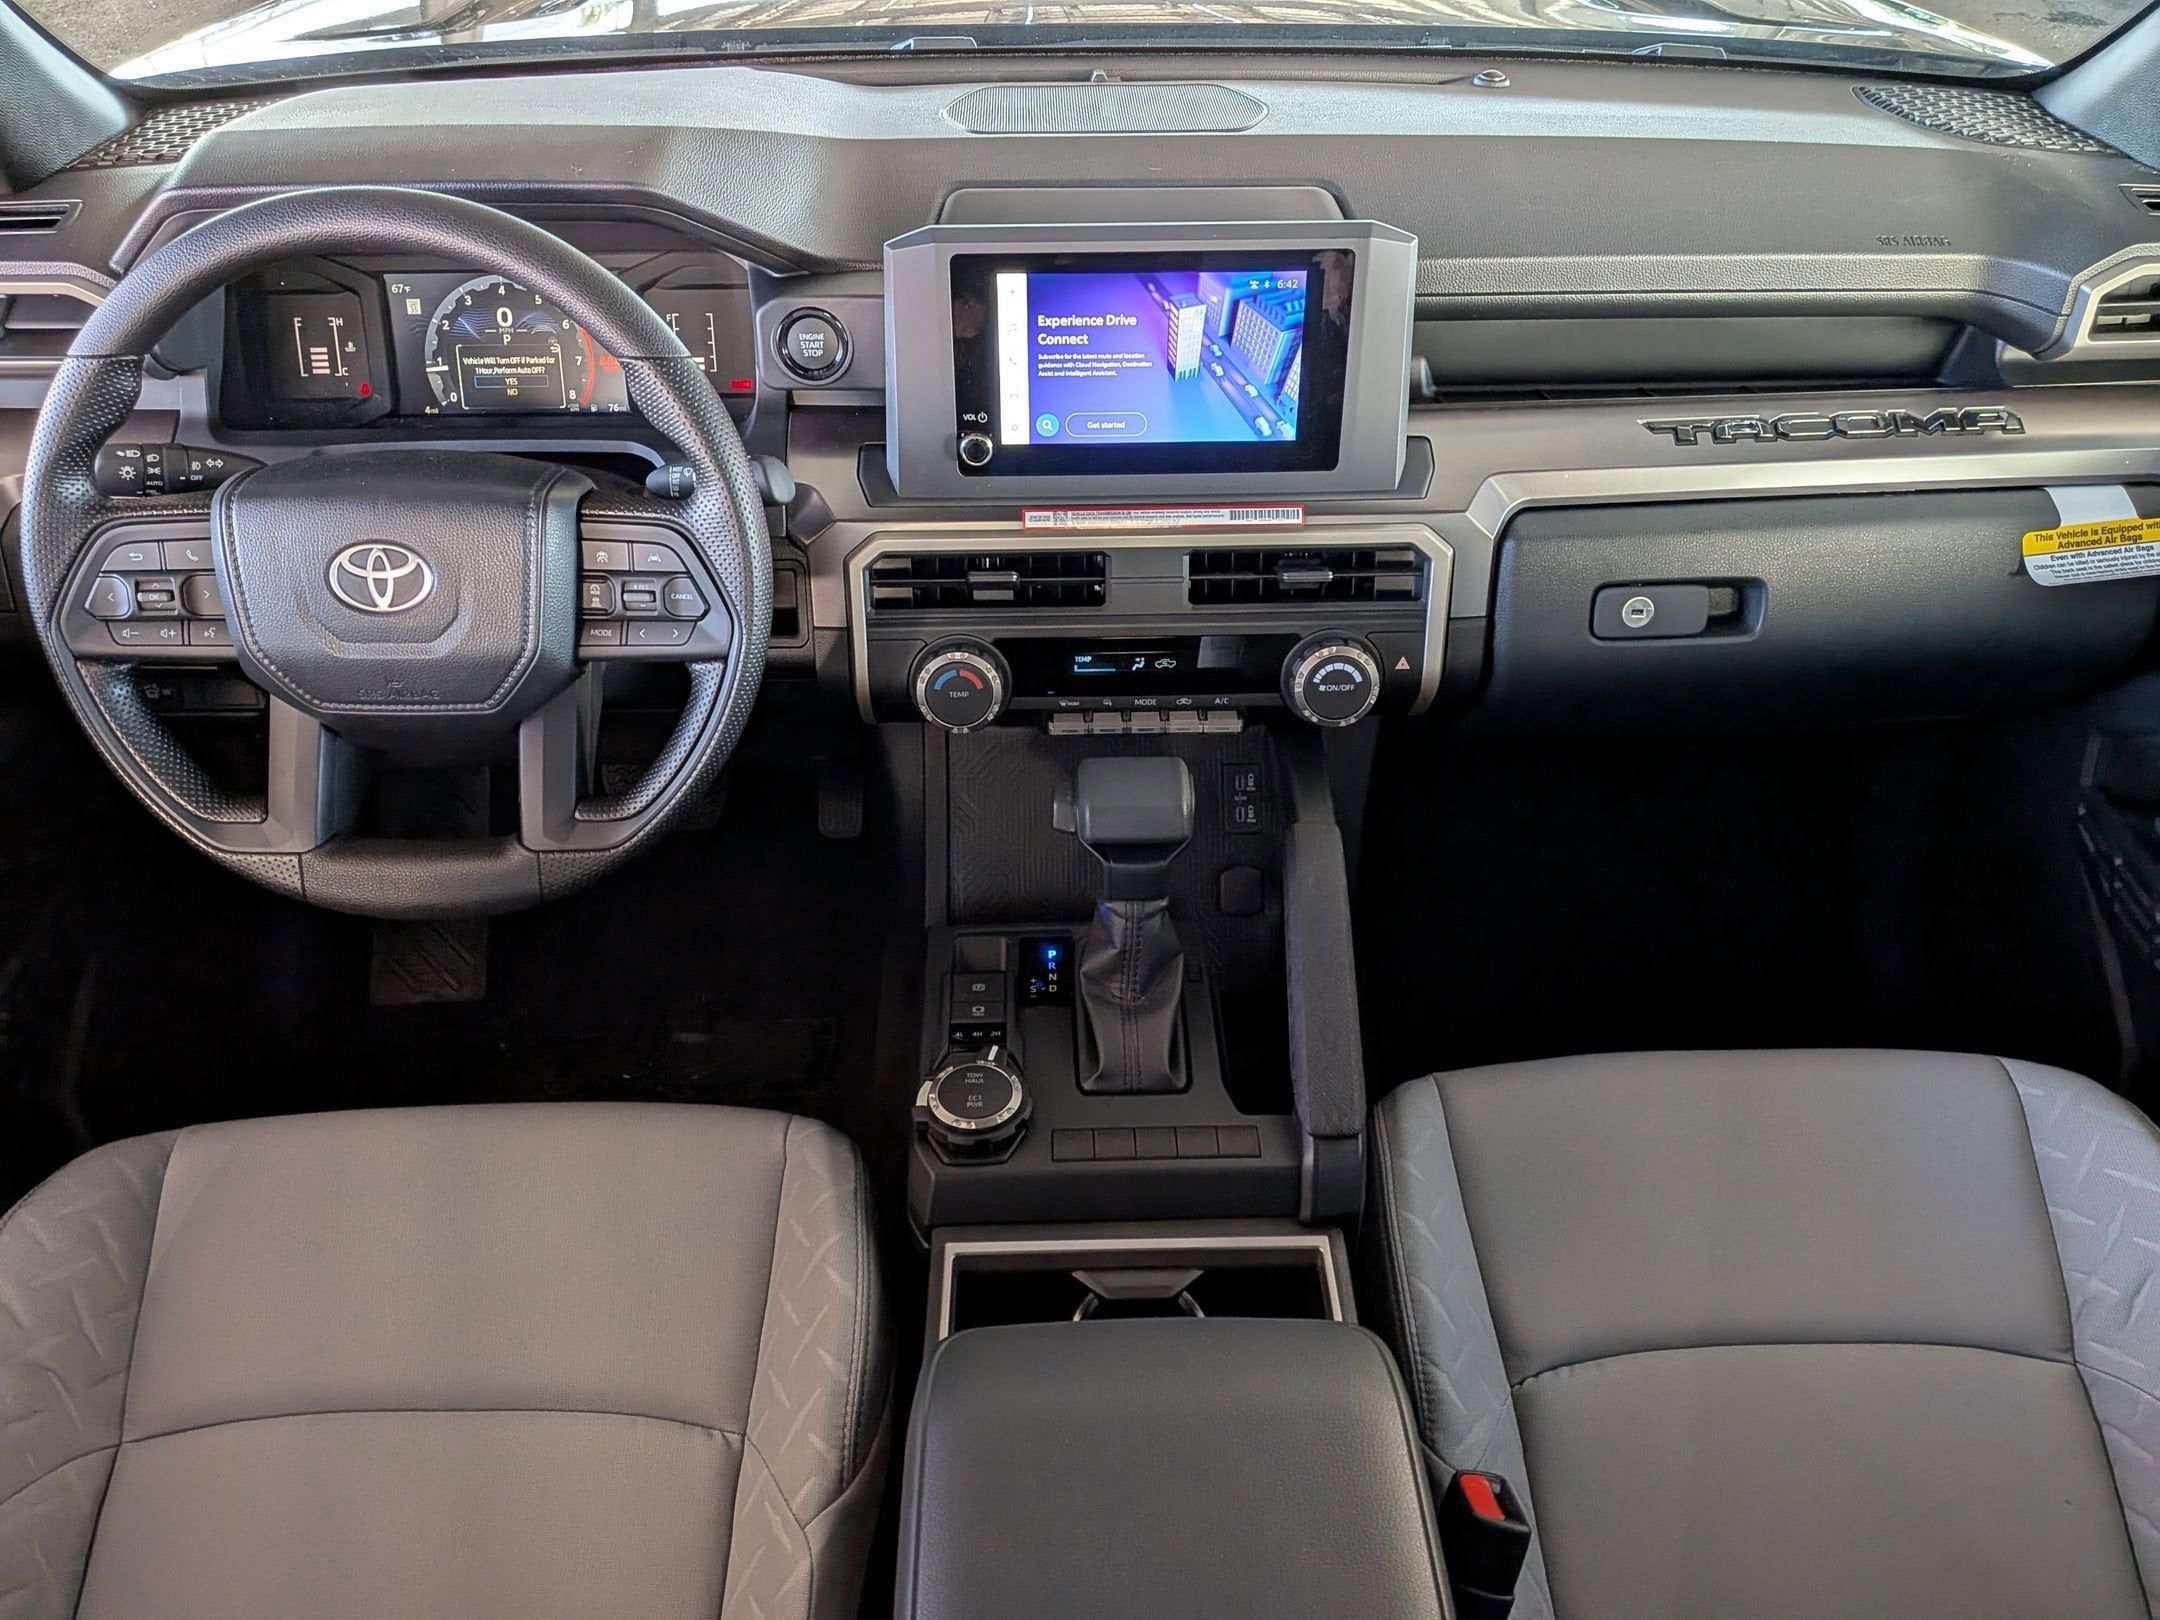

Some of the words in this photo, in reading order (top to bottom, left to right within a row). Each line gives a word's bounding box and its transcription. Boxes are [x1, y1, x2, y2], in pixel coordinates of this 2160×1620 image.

[1277, 279, 1298, 289] 6:42
[497, 286, 506, 296] 4
[464, 296, 472, 306] 3
[535, 295, 542, 305] 5
[336, 318, 343, 326] H
[496, 307, 513, 328] 0
[1037, 314, 1103, 329] Experience
[1105, 314, 1137, 327] Drive
[441, 319, 450, 330] 2
[562, 319, 570, 330] 6
[503, 334, 511, 346] P
[799, 333, 825, 341] ENGINE
[1037, 332, 1089, 346] Connect
[800, 341, 824, 349] START
[803, 349, 823, 357] STOP
[463, 357, 483, 365] Vehicle
[483, 357, 496, 365] Will
[510, 356, 521, 364] OFF
[526, 356, 546, 364] Parked
[575, 356, 582, 366] 7
[1038, 361, 1062, 369] guidance
[1092, 361, 1122, 369] Navigation,
[342, 367, 349, 376] C
[517, 366, 531, 374] Auto
[449, 393, 457, 403] 0
[569, 389, 577, 400] 8
[963, 413, 976, 421] VOL
[1087, 421, 1100, 429] Get
[1101, 421, 1126, 429] started
[1636, 405, 2026, 446] TACOMA
[2034, 532, 2053, 543] This
[2056, 528, 2089, 540] Vehicle
[2091, 527, 2099, 536] is
[2101, 523, 2143, 535] Equipped
[2057, 537, 2103, 550] Advanced
[2104, 535, 2118, 545] Air
[2120, 533, 2143, 544] Bags
[2050, 554, 2069, 562] Even
[2070, 552, 2086, 560] with
[2087, 548, 2122, 557] Advanced
[2124, 546, 2134, 554] Air
[670, 592, 693, 600] CANCEL
[1326, 684, 1355, 692] ON/OFF
[1134, 698, 1157, 706] MODE
[1214, 697, 1229, 705] A/C
[1048, 950, 1057, 959] P
[1048, 962, 1057, 970] R
[1049, 973, 1057, 981] N
[1049, 984, 1057, 992] D
